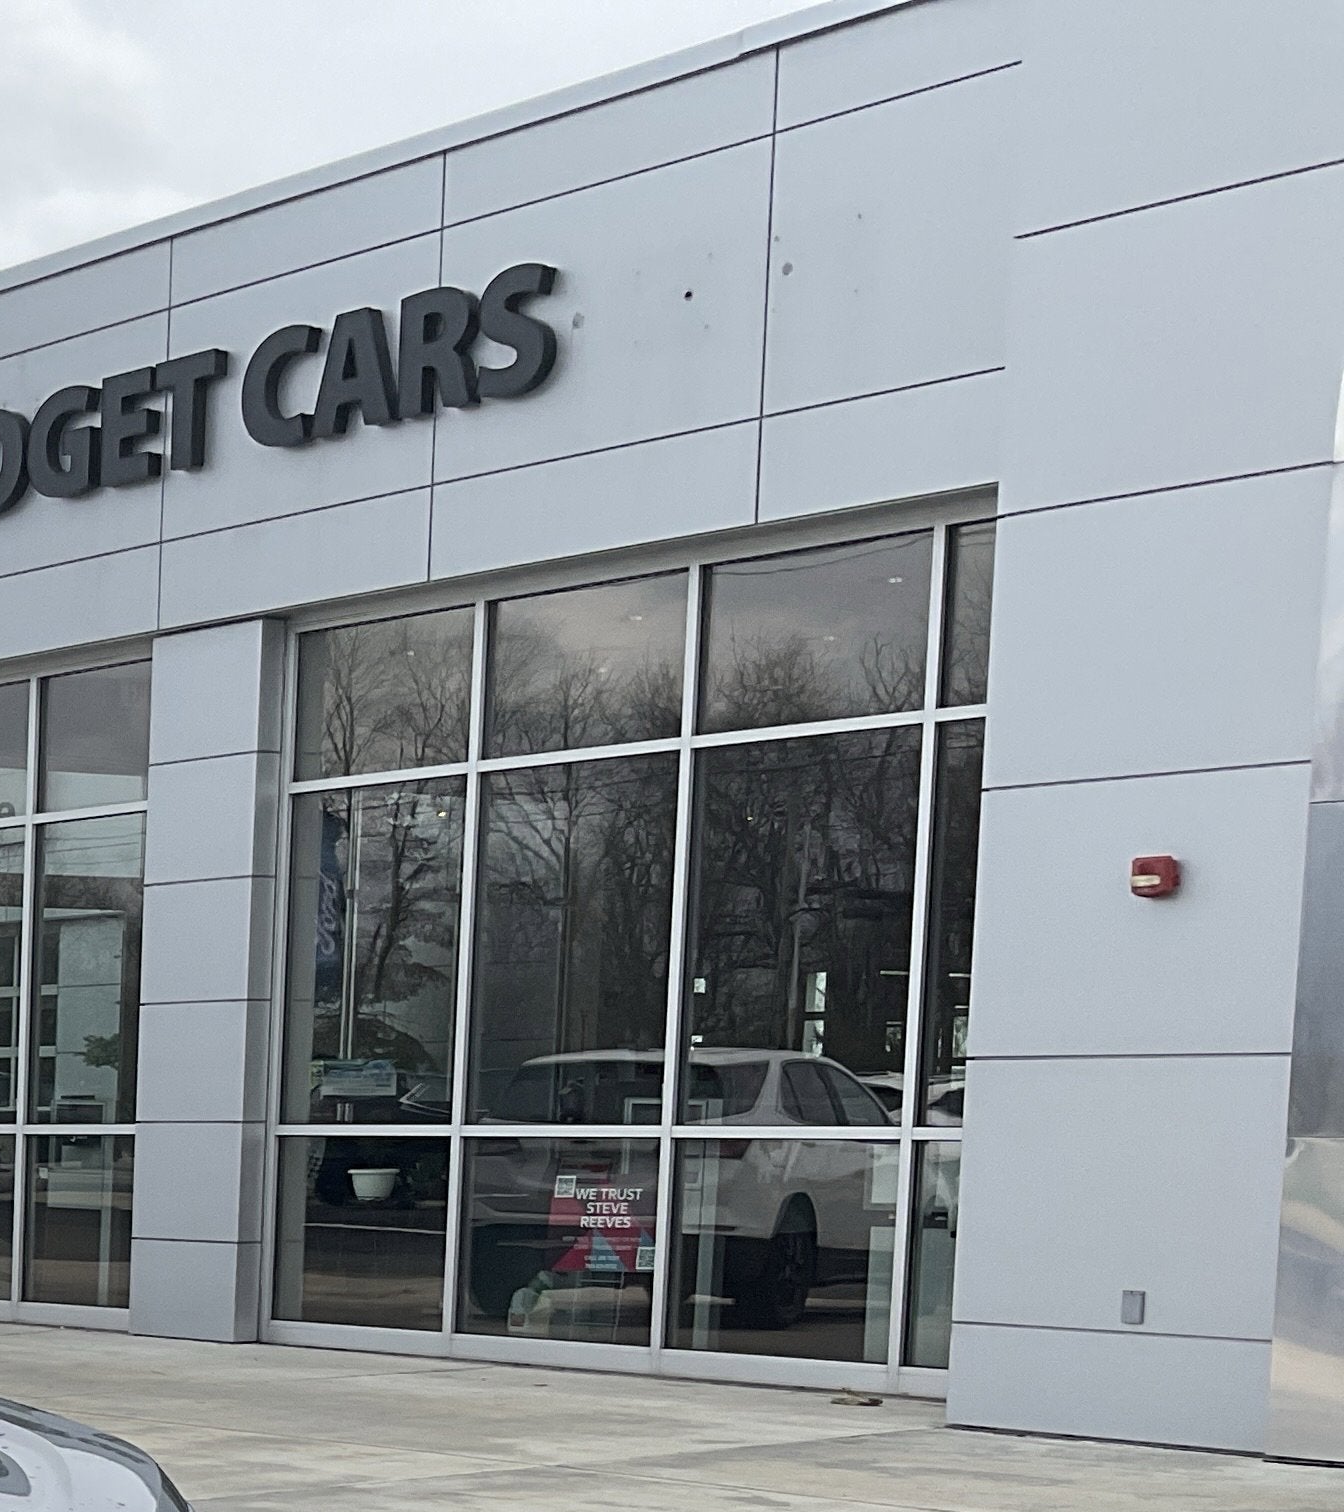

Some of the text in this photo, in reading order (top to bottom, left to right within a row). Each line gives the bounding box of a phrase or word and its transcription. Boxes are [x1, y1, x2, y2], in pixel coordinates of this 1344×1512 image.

[241, 263, 558, 448] CARS
[575, 1188, 643, 1200] WE TRUST
[586, 1202, 629, 1214] STEVE
[580, 1216, 631, 1228] REEVES
